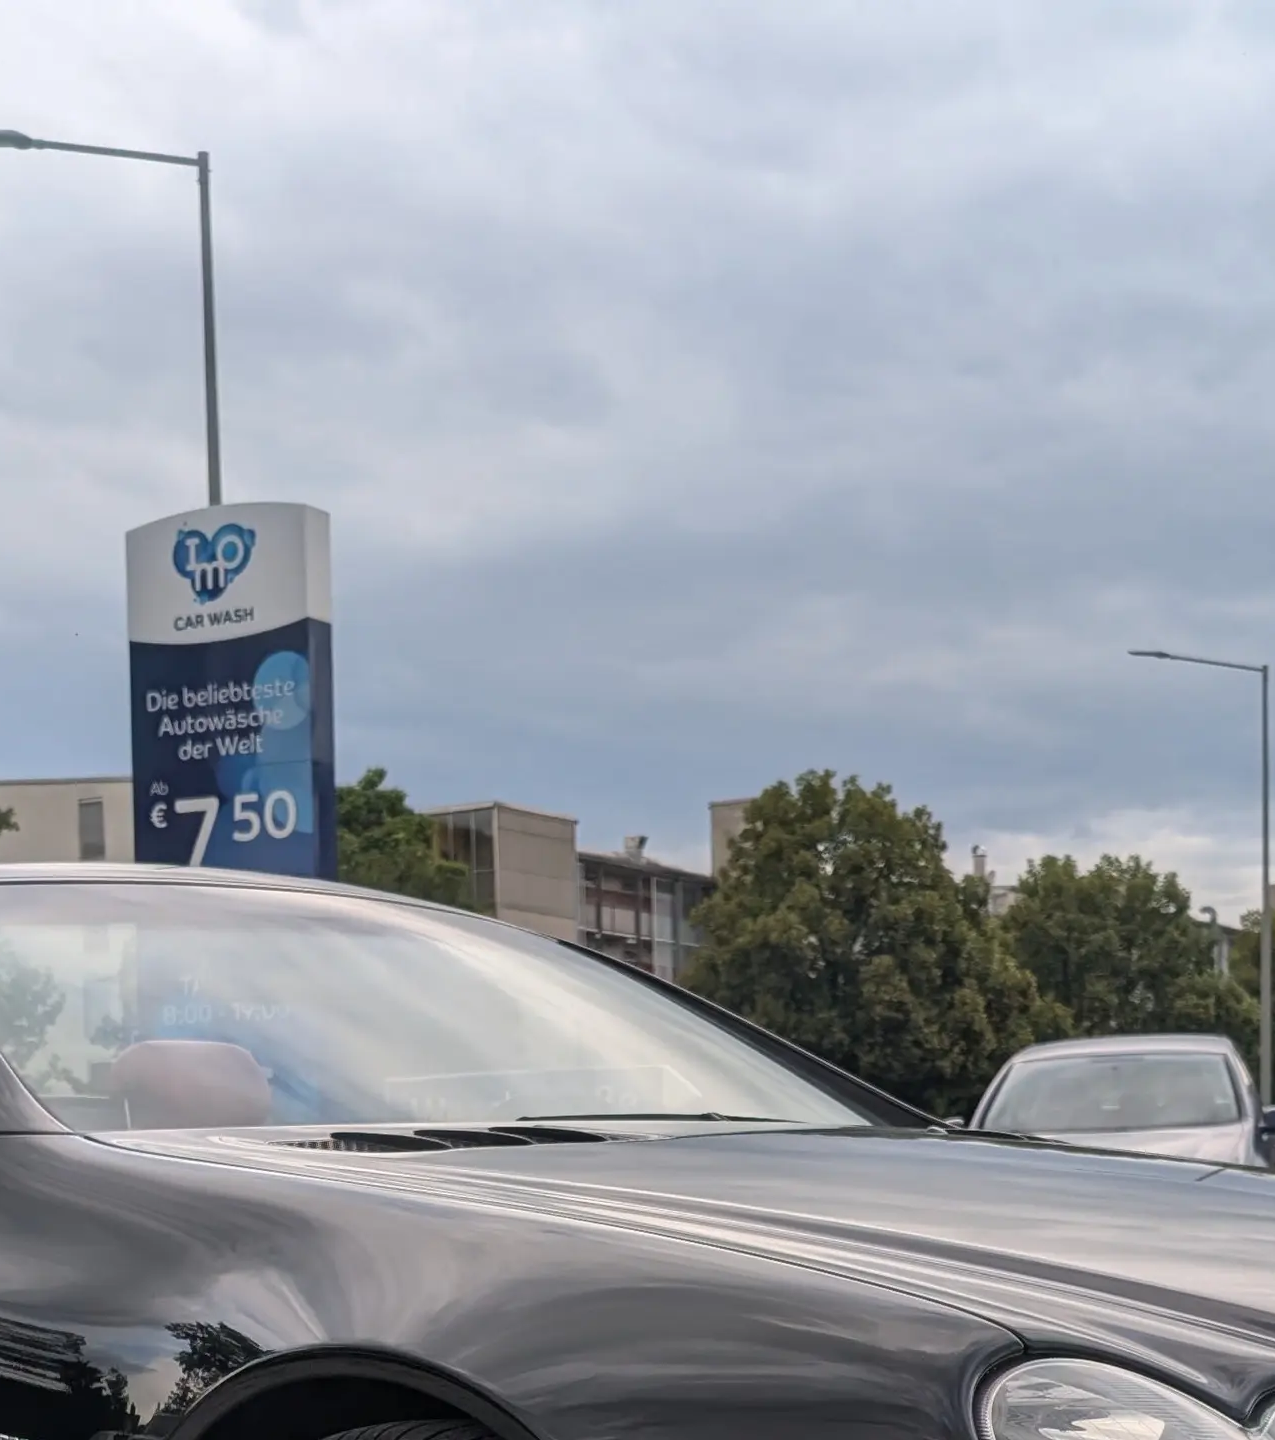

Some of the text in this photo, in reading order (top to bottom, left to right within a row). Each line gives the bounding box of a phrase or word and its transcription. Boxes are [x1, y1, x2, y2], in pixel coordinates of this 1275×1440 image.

[174, 607, 254, 632] CAR WASH
[146, 678, 296, 713] Die beliebteste
[158, 708, 284, 738] Autowäsche
[178, 734, 264, 761] der Welt
[149, 781, 169, 797] Ab
[174, 796, 219, 867] 7
[231, 790, 297, 842] 50
[162, 1001, 212, 1025] 8:00
